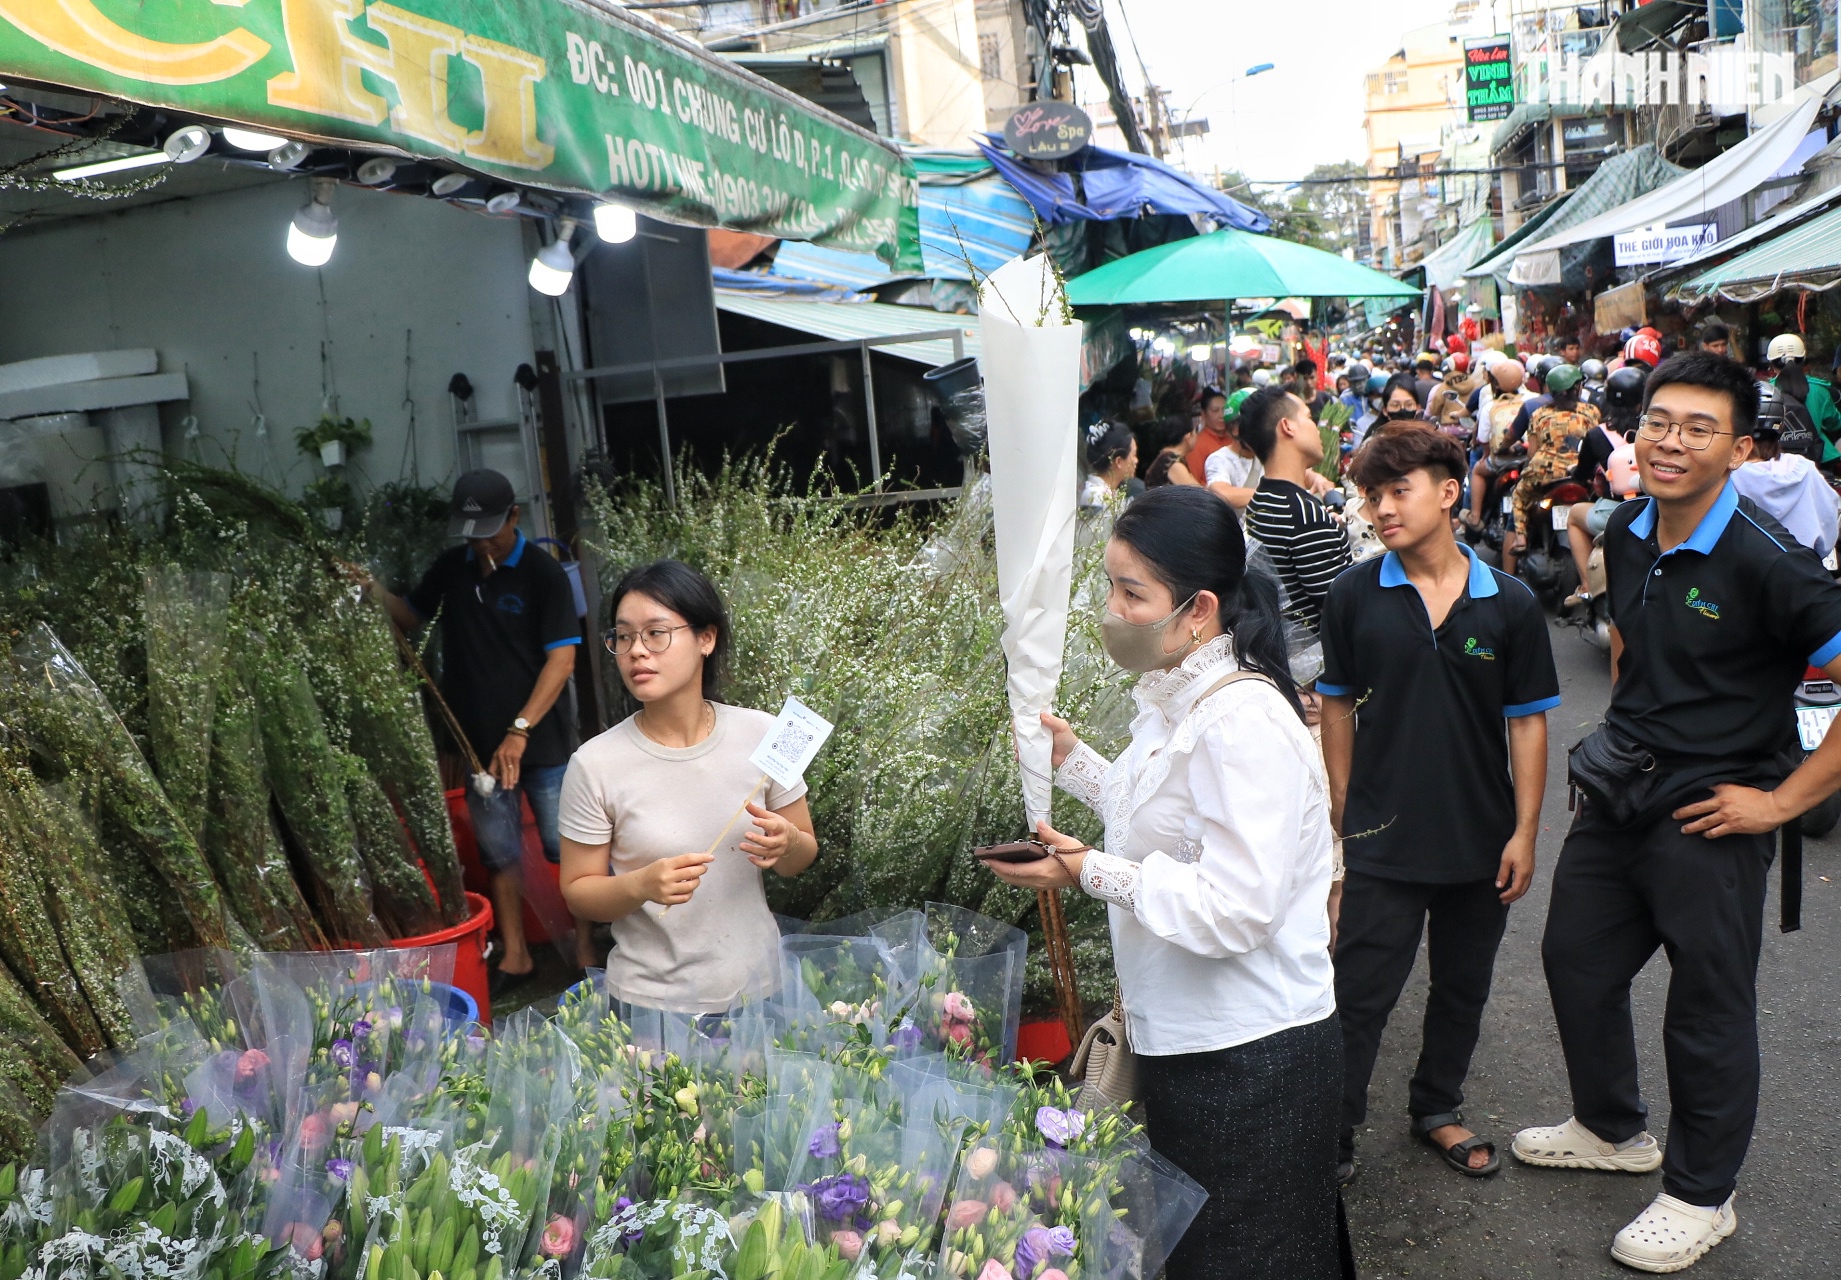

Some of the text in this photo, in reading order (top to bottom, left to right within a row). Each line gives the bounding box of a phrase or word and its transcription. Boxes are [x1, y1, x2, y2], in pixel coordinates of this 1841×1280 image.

[1468, 62, 1509, 82] VINH
[566, 31, 619, 96] ĐC:
[624, 54, 671, 115] 001
[673, 77, 741, 145] CHUNG
[744, 107, 767, 154] CƯ
[770, 113, 791, 163] LÔ
[1057, 124, 1085, 140] Spa
